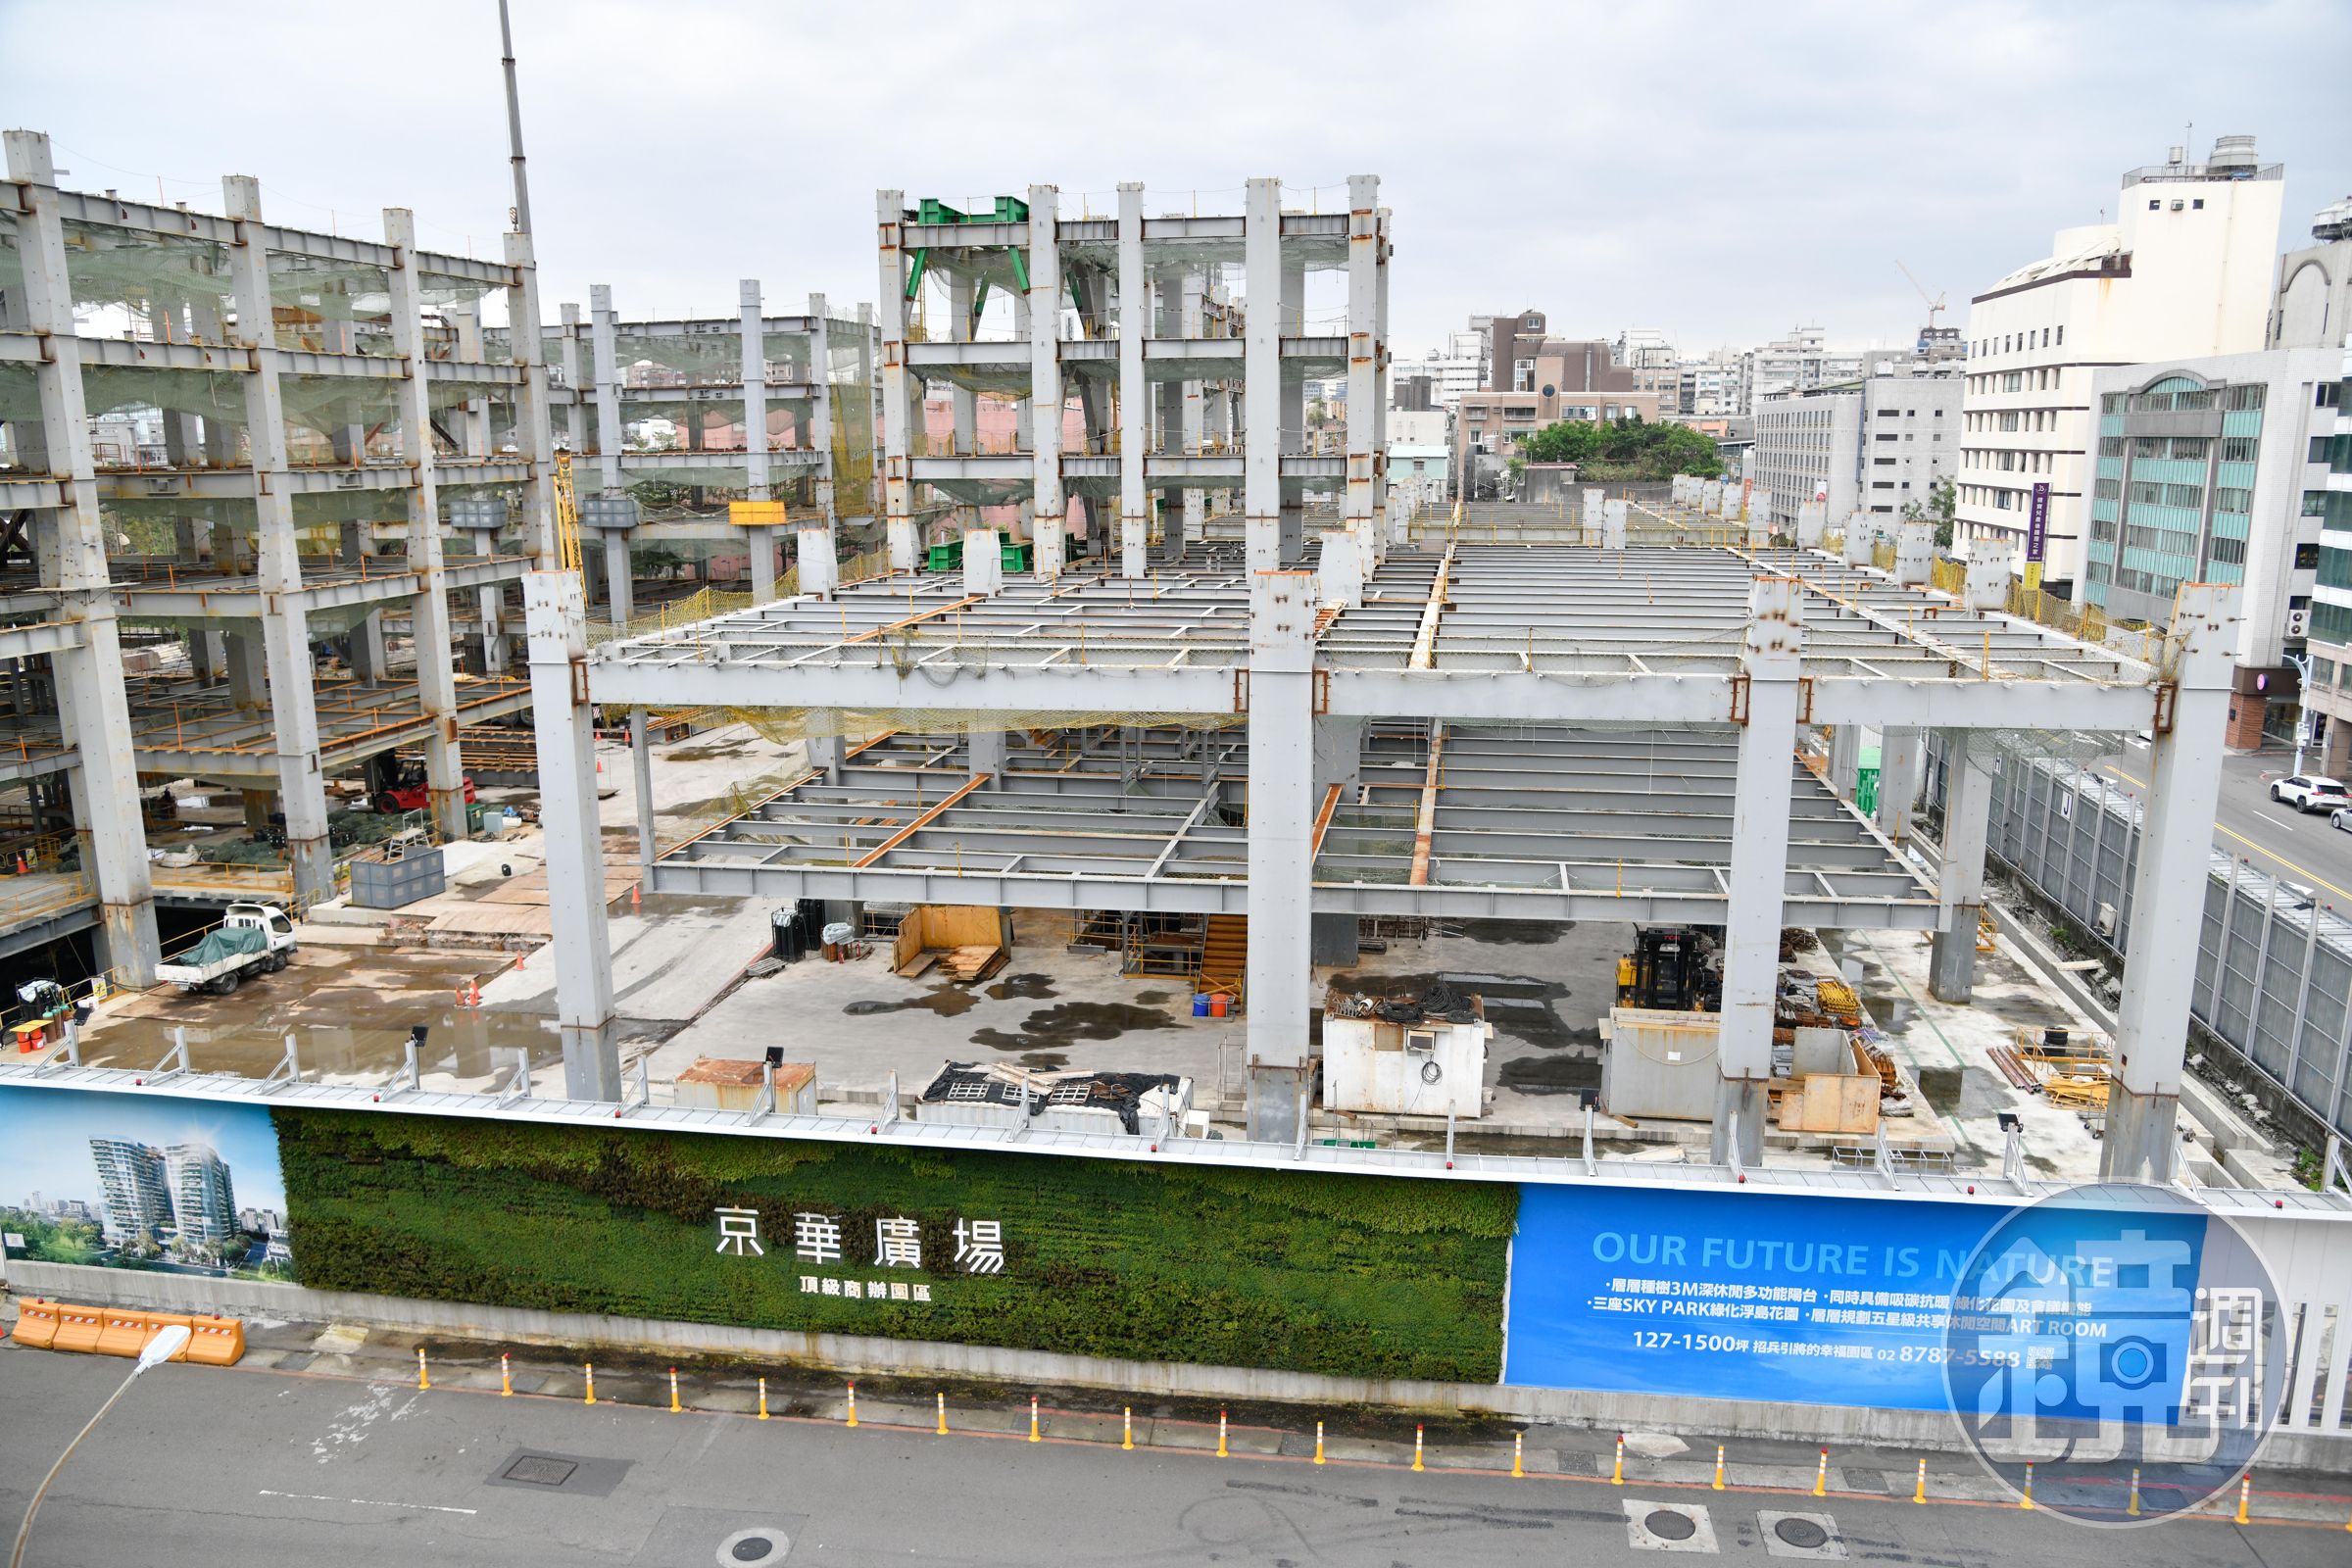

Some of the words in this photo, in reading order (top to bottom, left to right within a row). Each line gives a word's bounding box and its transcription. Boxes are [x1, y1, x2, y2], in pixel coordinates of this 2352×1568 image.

[2064, 795, 2070, 815] J
[713, 1203, 1004, 1274] 京華廣場
[1592, 1232, 1687, 1266] OUR
[1701, 1237, 1869, 1276] FUTURE
[1884, 1246, 1920, 1278] IS
[1936, 1250, 2113, 1287] NATURE
[799, 1275, 932, 1302] 頂級商辦園區
[2047, 1320, 2108, 1338] ROOM
[1877, 1349, 1895, 1361] 02
[1899, 1345, 2021, 1367] 8787-5588
